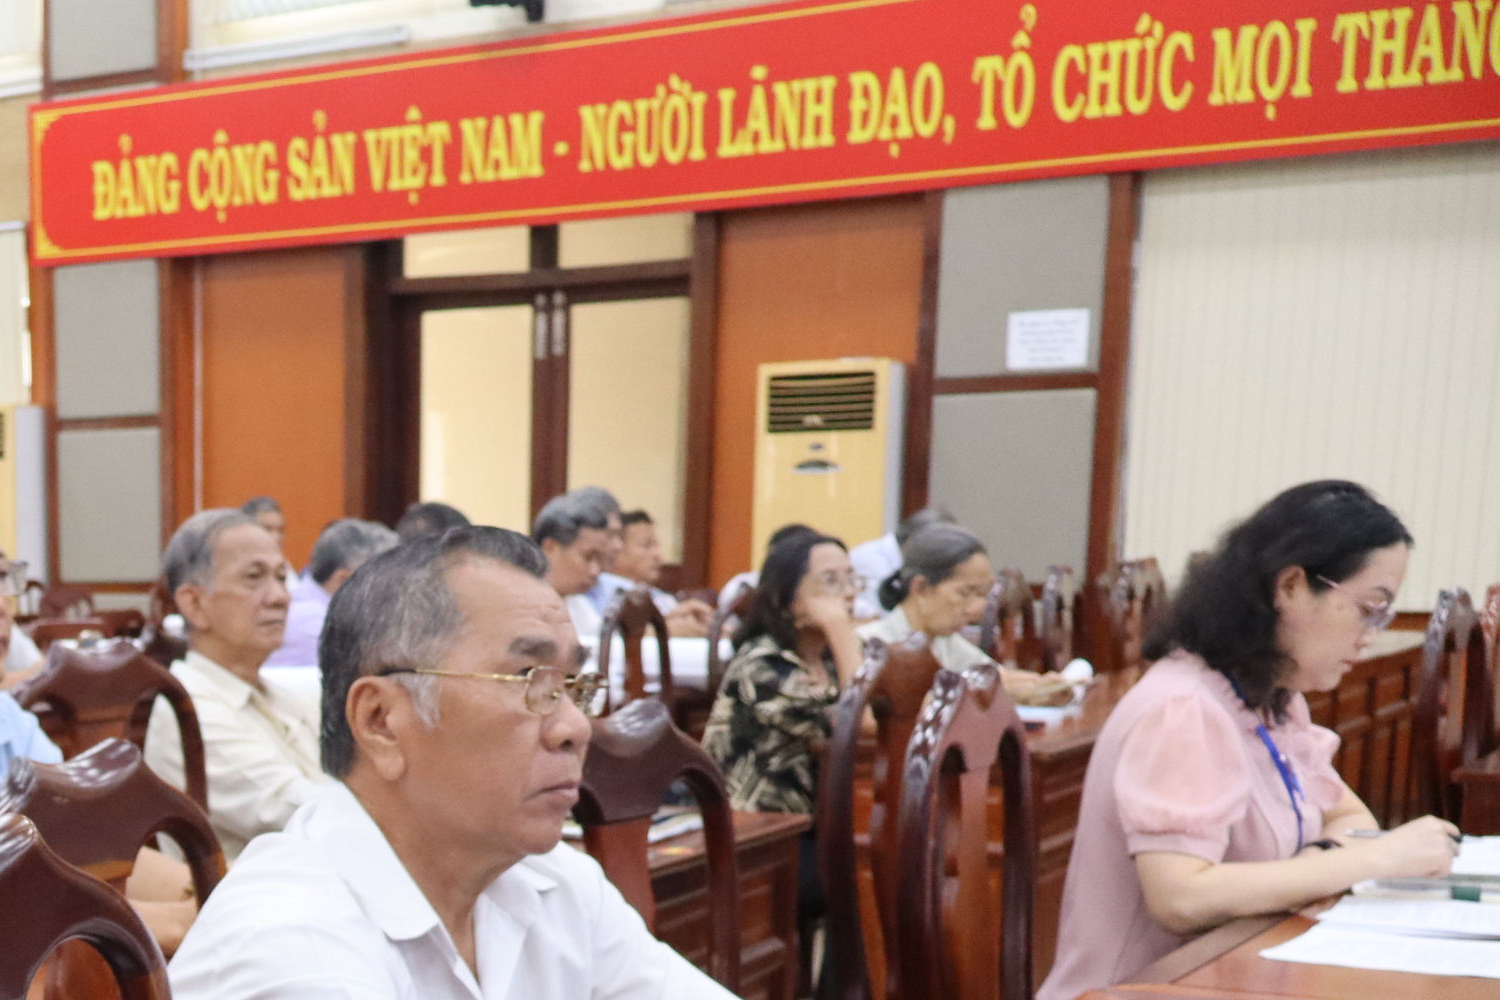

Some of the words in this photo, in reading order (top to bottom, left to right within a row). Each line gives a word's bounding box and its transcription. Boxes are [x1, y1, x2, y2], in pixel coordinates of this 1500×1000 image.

[92, 134, 181, 221] ĐẢNG
[188, 130, 280, 222] CỘNG
[287, 110, 357, 201] SẢN
[363, 106, 451, 204] VIỆT
[459, 110, 545, 184] NAM
[578, 74, 708, 173] NGƯỜI
[847, 62, 955, 158] ĐẠO,
[972, 4, 1037, 130] TỔ
[1052, 13, 1195, 122] CHỨC
[1208, 18, 1318, 120] MỌI
